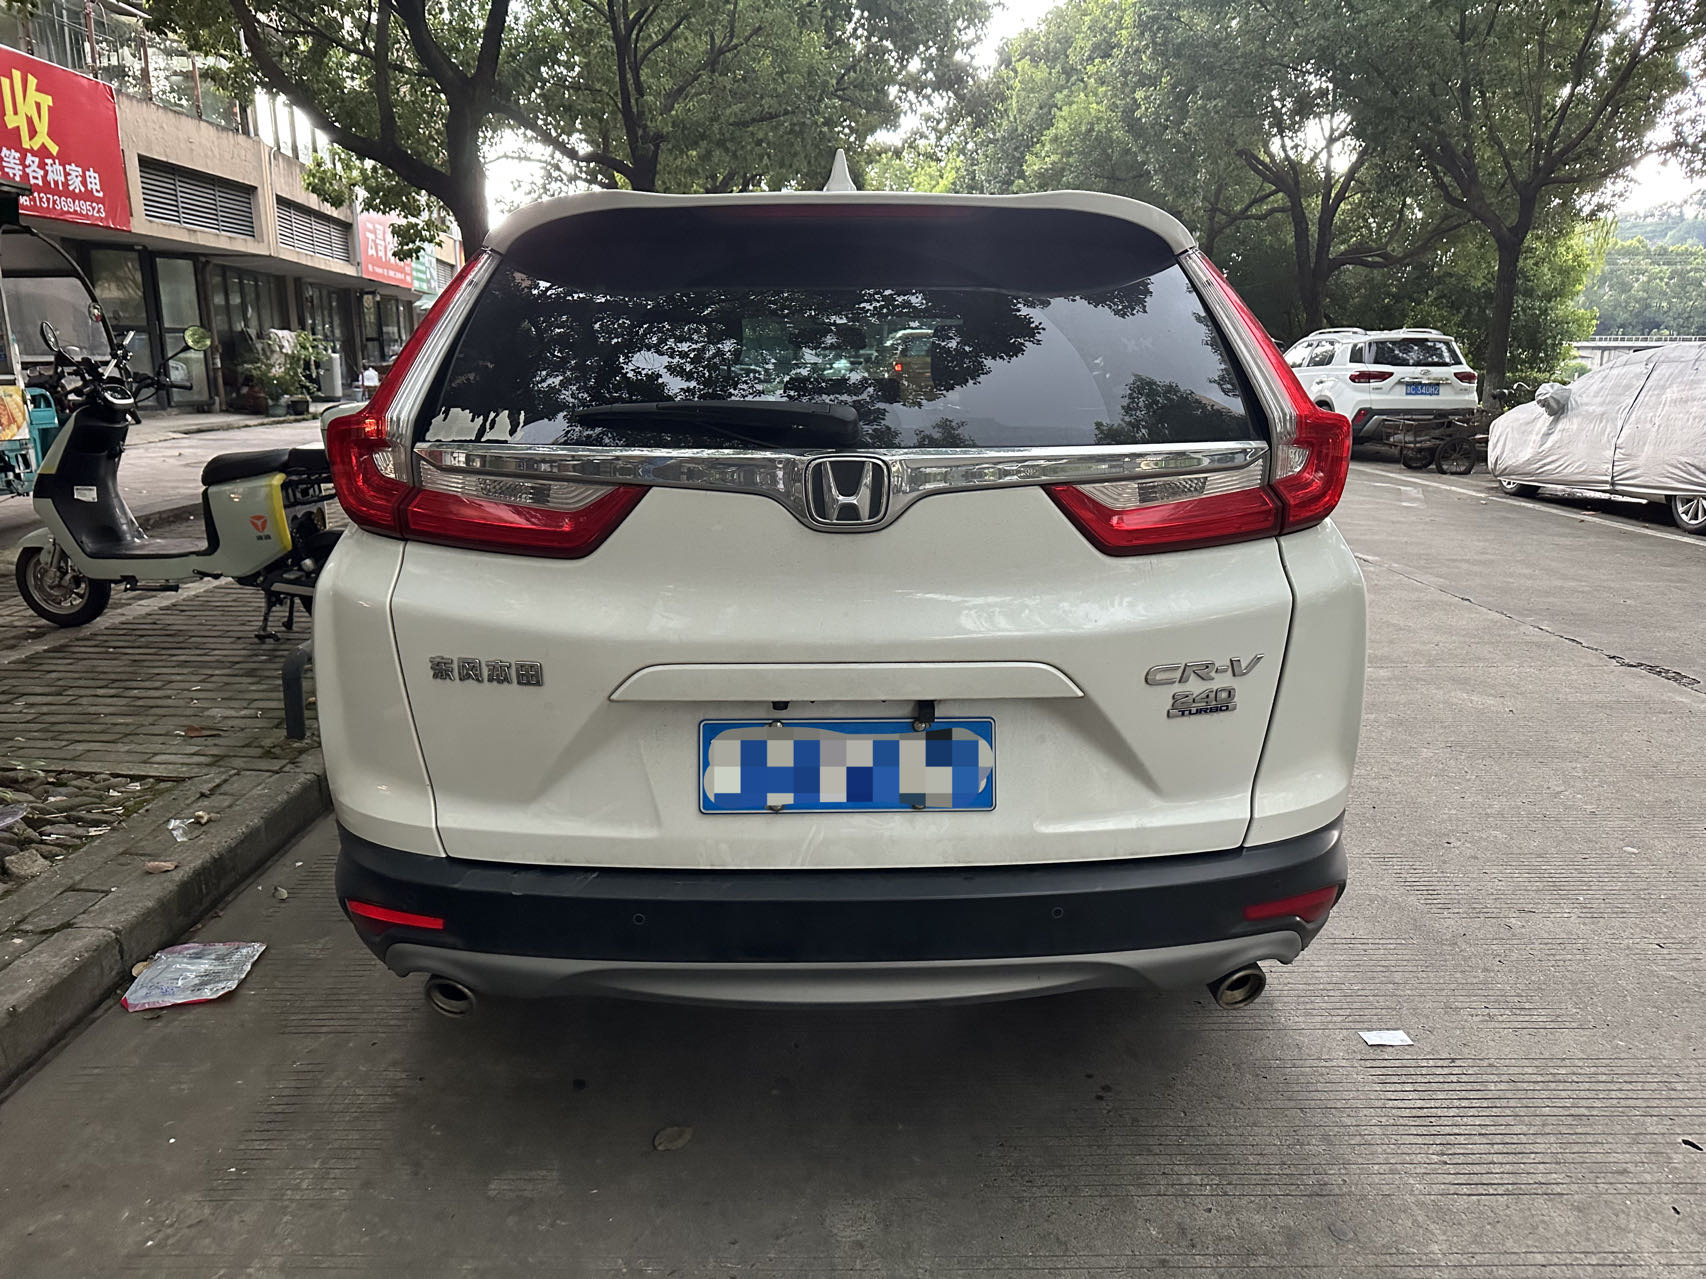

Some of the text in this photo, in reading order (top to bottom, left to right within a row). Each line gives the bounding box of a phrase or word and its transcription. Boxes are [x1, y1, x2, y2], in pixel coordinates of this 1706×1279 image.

[1, 68, 59, 156] 收
[1, 146, 104, 198] 等各种家电
[429, 655, 544, 687] 东风本田
[1144, 653, 1265, 686] CR-V
[1171, 686, 1237, 709] 240
[1178, 704, 1230, 716] TURBO
